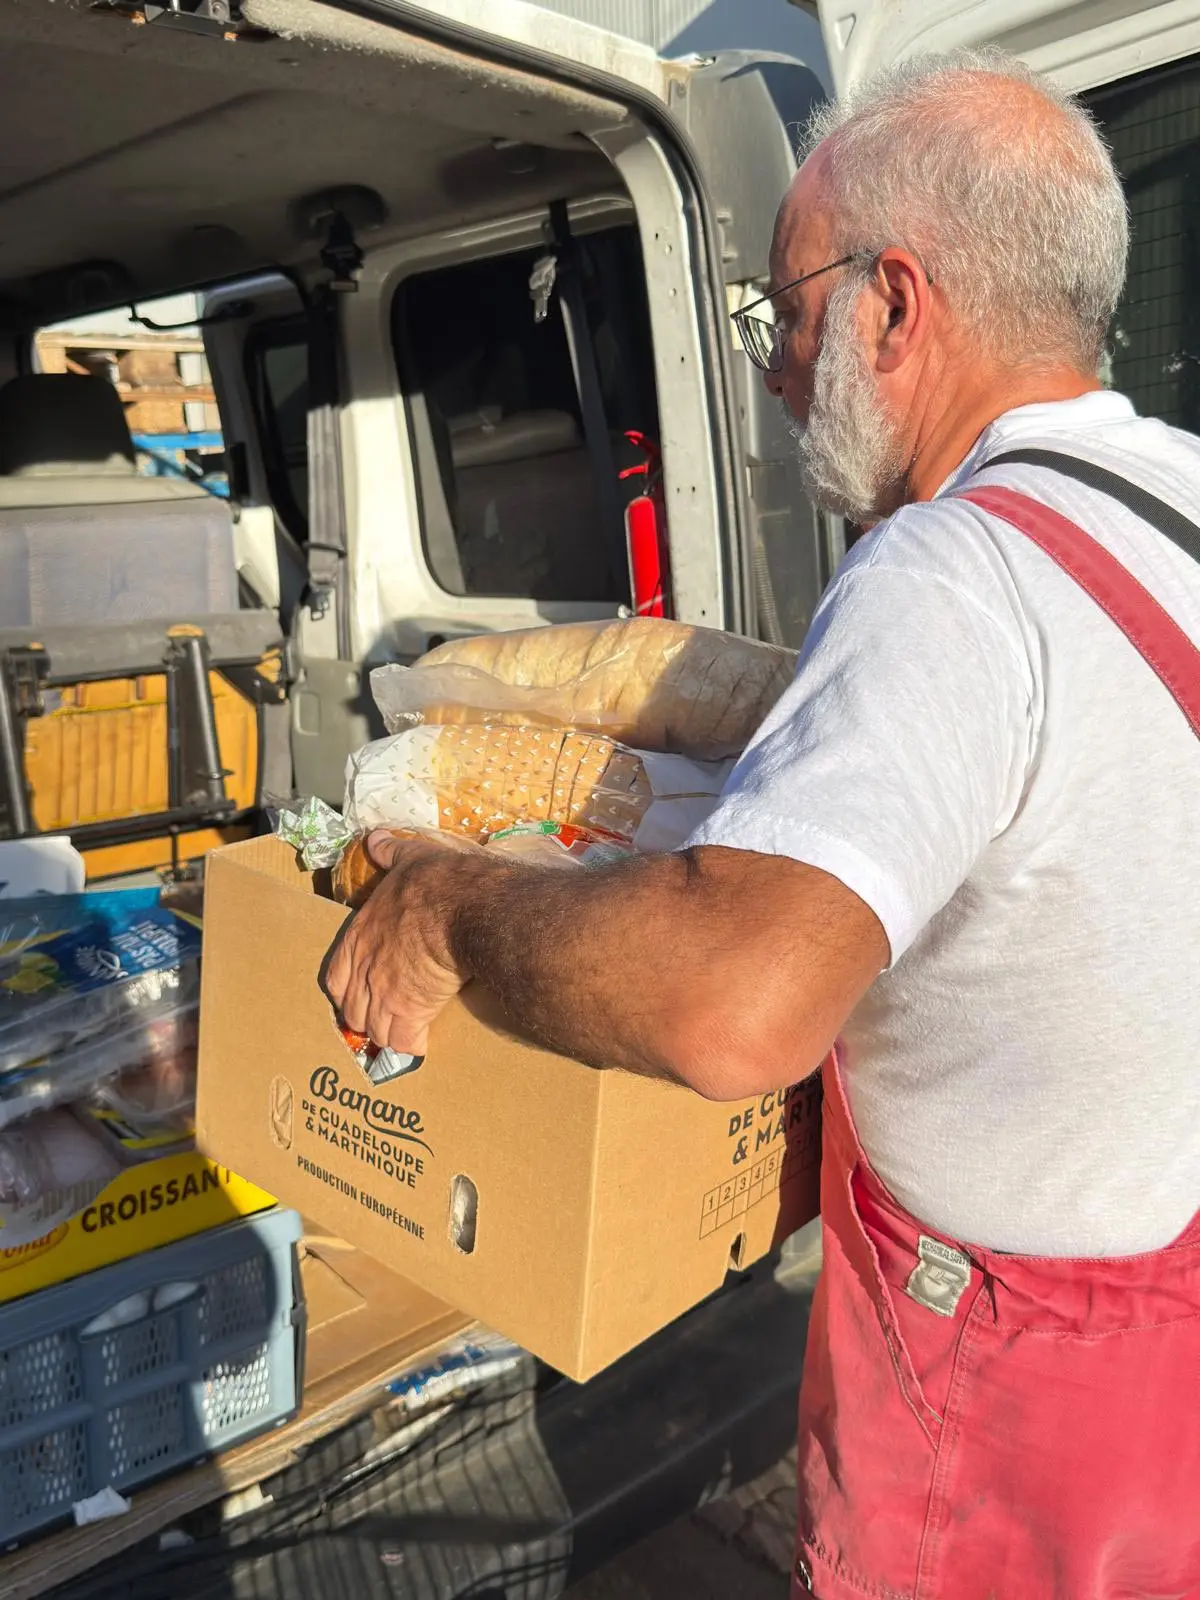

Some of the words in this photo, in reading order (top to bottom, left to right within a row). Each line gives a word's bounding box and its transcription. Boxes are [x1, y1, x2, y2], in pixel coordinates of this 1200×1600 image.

[310, 1066, 425, 1136] Banane
[728, 1107, 754, 1137] DE
[302, 1099, 316, 1115] DE
[320, 1106, 424, 1174] GUADELOUPE
[305, 1116, 315, 1132] &
[318, 1125, 416, 1188] MARTINIQUE
[732, 1136, 748, 1165] &
[297, 1155, 358, 1201] PRODUCTION
[360, 1191, 425, 1240] EUROPÉENNE
[708, 1195, 714, 1210] 1
[723, 1186, 731, 1200] 2
[739, 1177, 747, 1190] 3
